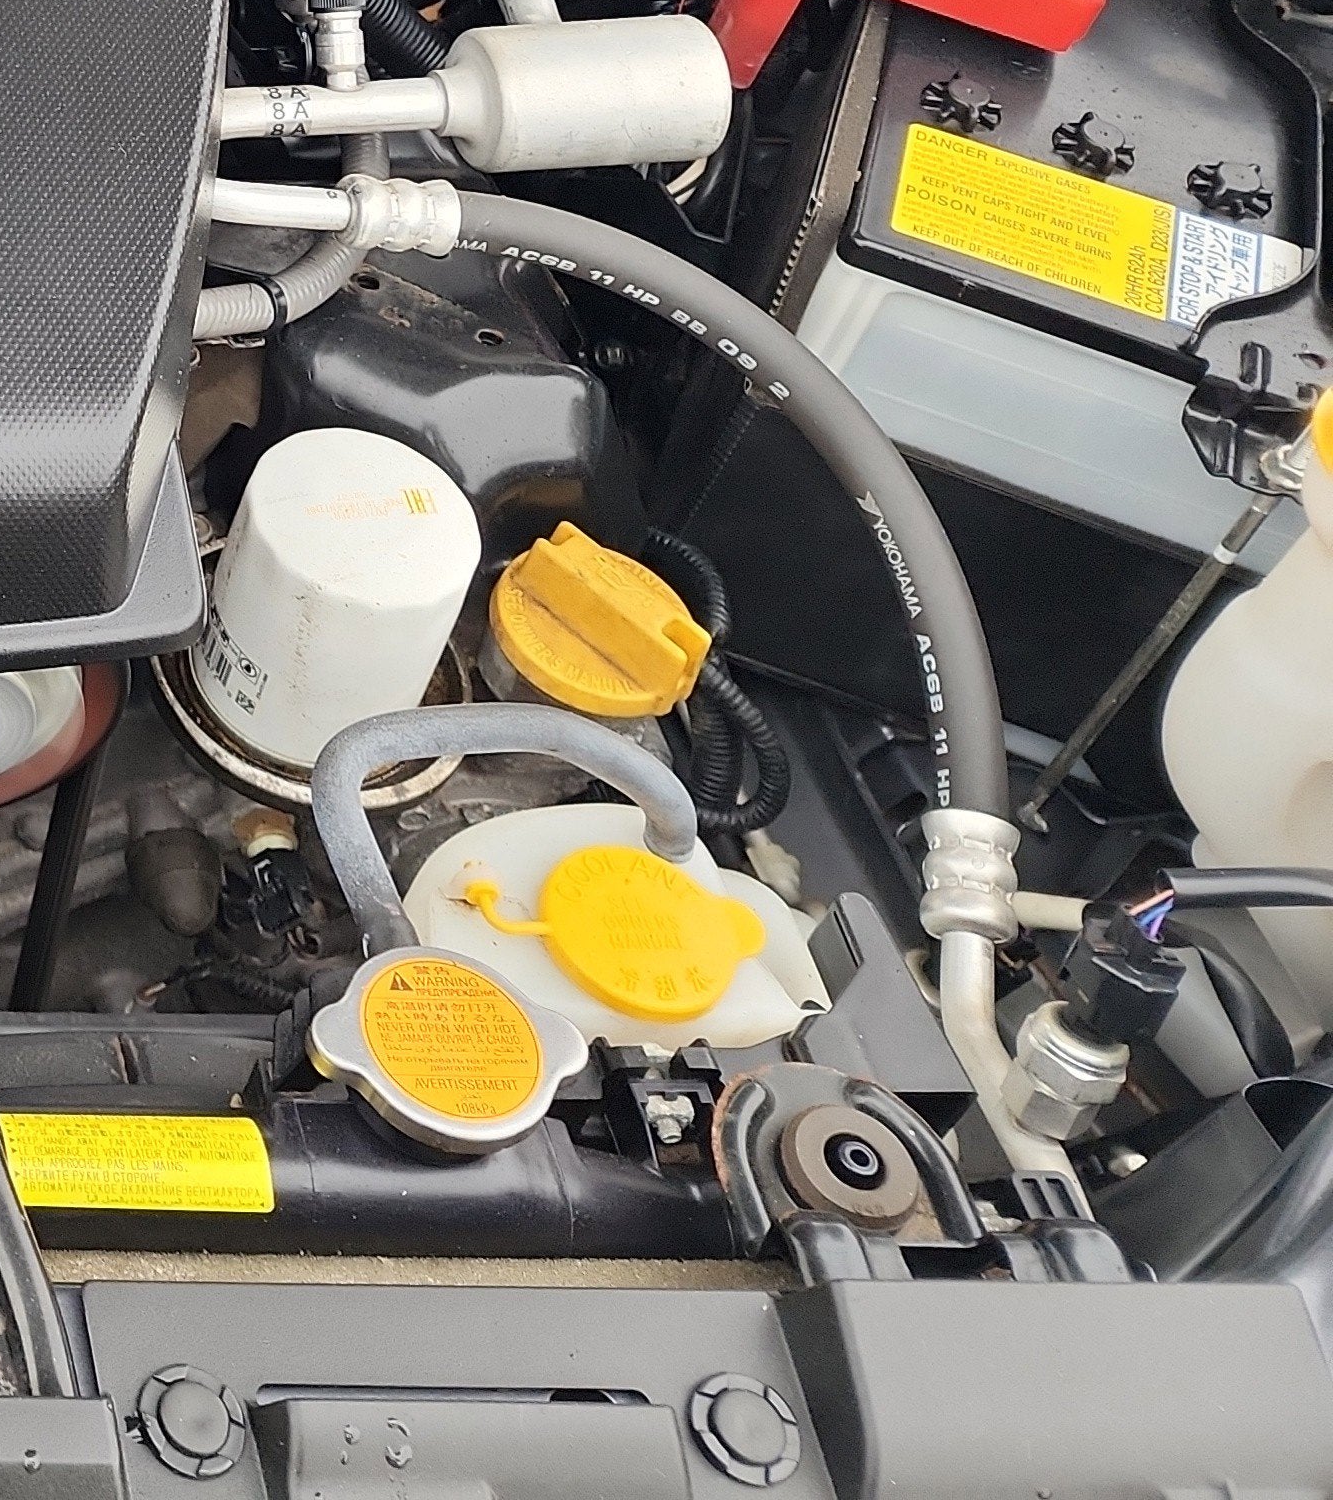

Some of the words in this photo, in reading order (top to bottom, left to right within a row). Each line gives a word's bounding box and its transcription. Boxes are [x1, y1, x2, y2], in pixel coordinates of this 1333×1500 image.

[267, 86, 282, 100] 8
[290, 86, 307, 98] A
[273, 102, 285, 120] 8
[293, 101, 309, 119] A
[270, 123, 285, 136] 8
[290, 122, 307, 136] A
[915, 130, 989, 162] DANGER
[994, 156, 1053, 183] EXPLOSIVE
[1055, 176, 1092, 195] GASES
[905, 184, 977, 217] POISON
[983, 211, 1026, 233] CAUSES
[1030, 226, 1071, 247] SEVERE
[1074, 239, 1112, 261] BURNS
[921, 175, 949, 190] KEEP
[952, 184, 979, 202] VENT
[982, 194, 1011, 213] CAPS
[1015, 203, 1047, 223] TIGHT
[1050, 216, 1073, 231] AND
[1077, 225, 1111, 244] LEVEL
[1182, 215, 1208, 255] START
[912, 224, 940, 240] KEEP
[943, 233, 965, 248] OUT
[968, 241, 983, 254] OF
[986, 247, 1023, 268] REACH
[1026, 261, 1041, 274] OF
[1044, 266, 1102, 294] CHILDREN
[1129, 245, 1147, 275] 62Ah
[1148, 256, 1168, 287] 620A
[1187, 253, 1203, 267] &
[1204, 223, 1229, 299] アイドリング
[1179, 264, 1203, 298] STOP
[1144, 286, 1164, 314] CCA
[1177, 297, 1200, 325] FOR
[499, 246, 578, 273] AC6B
[588, 269, 616, 286] 11
[621, 283, 662, 307] HP
[669, 308, 709, 337] BB
[767, 380, 792, 401] 2
[872, 516, 924, 620] YOKOHAMA
[915, 633, 945, 714] AC6B
[933, 726, 949, 757] 11
[936, 768, 951, 808] HP
[412, 976, 480, 988] WARNING
[376, 1021, 414, 1033] NEVER
[419, 1022, 450, 1034] OPEN
[453, 1023, 490, 1035] WHEN
[397, 1034, 432, 1044] JAMAIS
[436, 1034, 473, 1045] OUVRIR
[414, 1077, 519, 1091] AVERTISSEMENT
[454, 1102, 497, 1115] 108kPa
[49, 1157, 101, 1169] APPROCHEZ
[107, 1158, 126, 1170] PAS
[130, 1159, 149, 1171] LES
